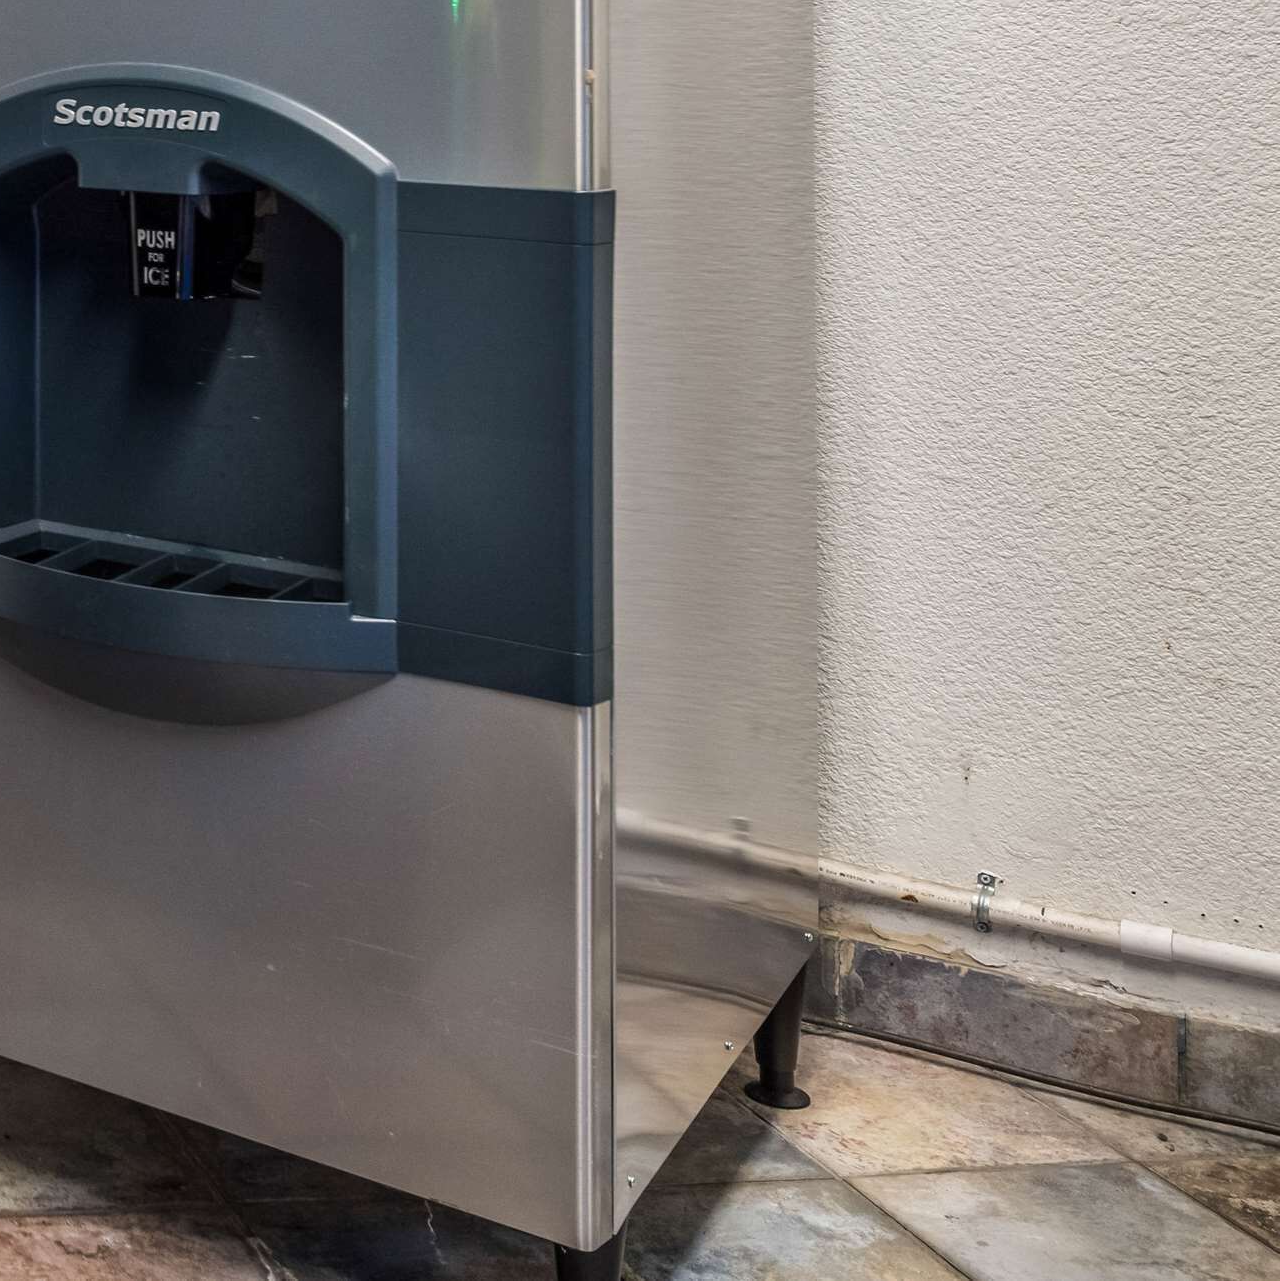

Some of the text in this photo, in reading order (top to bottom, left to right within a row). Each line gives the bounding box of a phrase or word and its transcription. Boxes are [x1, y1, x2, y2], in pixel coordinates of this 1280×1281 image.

[53, 98, 221, 132] Scotsman
[136, 228, 176, 250] PUSH
[147, 251, 164, 263] FOR
[143, 266, 170, 286] ICE
